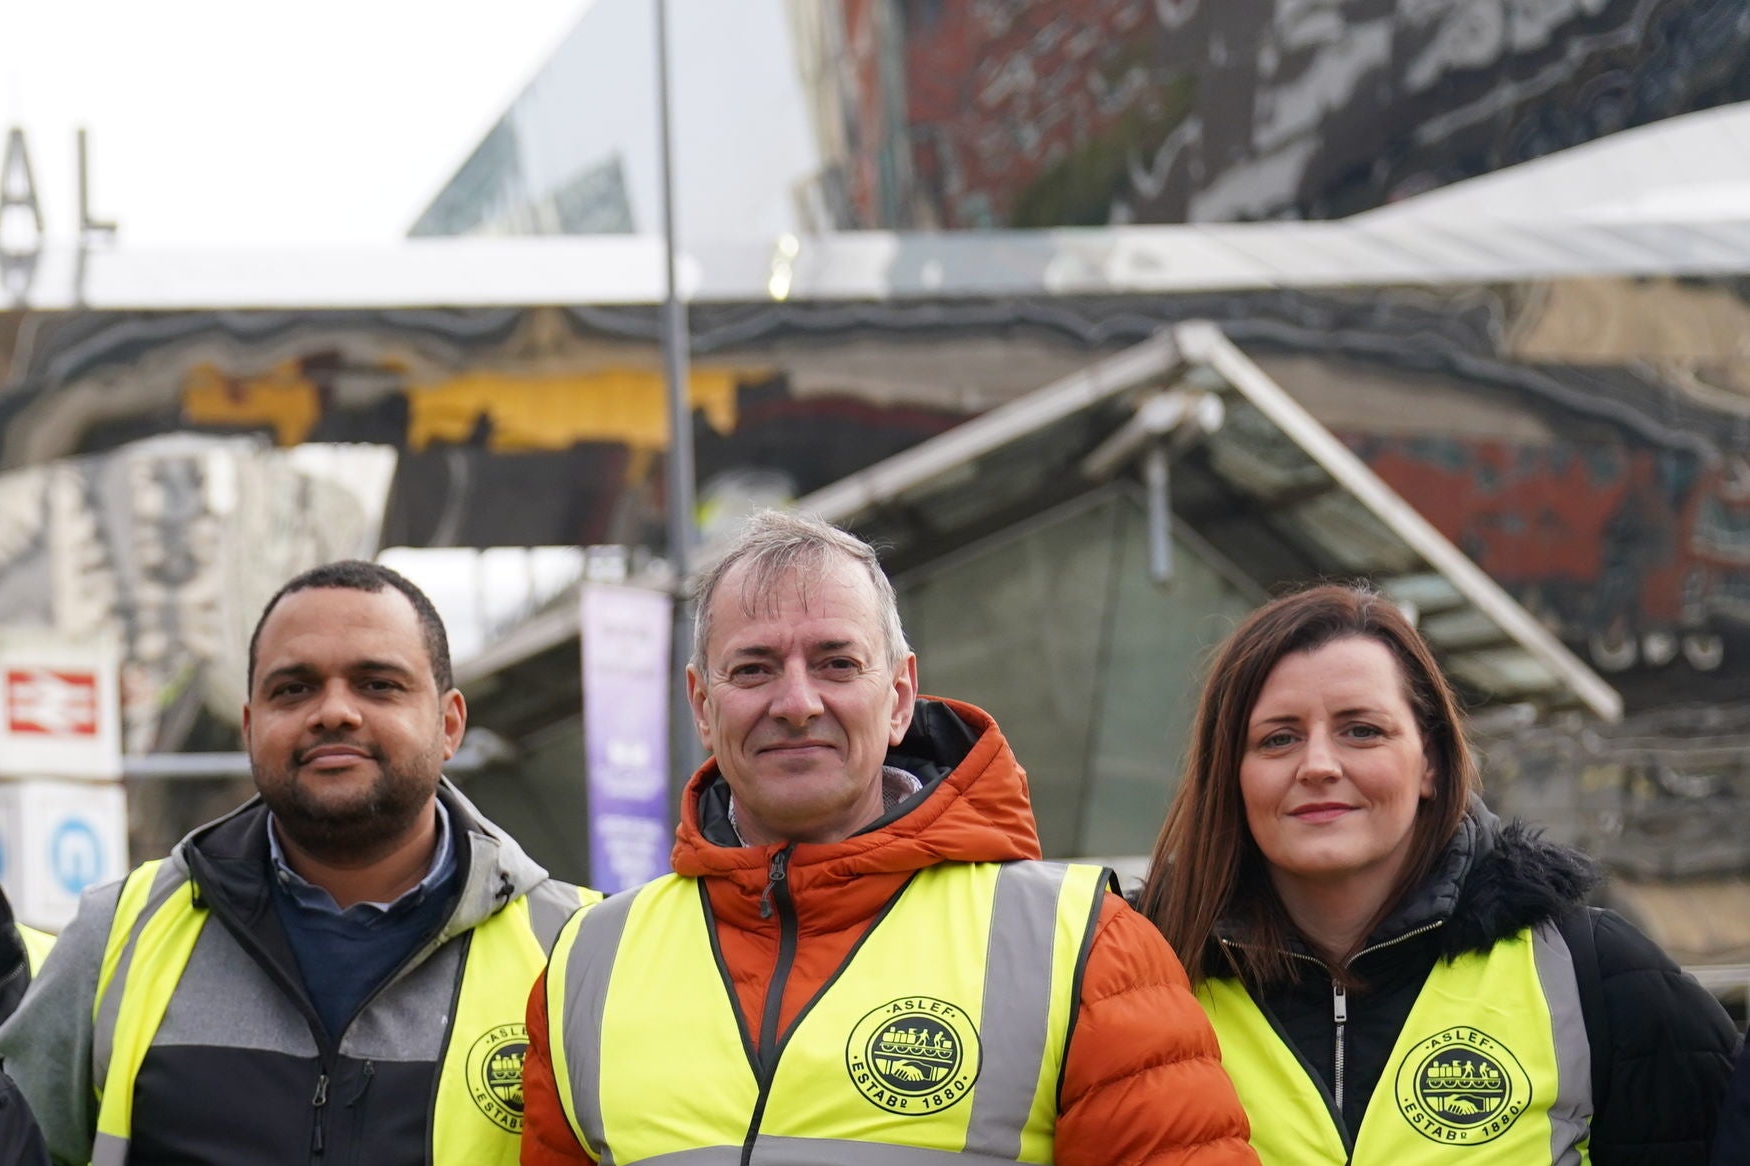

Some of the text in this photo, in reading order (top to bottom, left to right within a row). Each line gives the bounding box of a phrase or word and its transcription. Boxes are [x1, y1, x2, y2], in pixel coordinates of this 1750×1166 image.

[892, 999, 953, 1016] ASLEF
[489, 1027, 528, 1043] ASLE
[1430, 1030, 1491, 1049] ASLEF
[922, 1080, 966, 1109] 1880
[1482, 1104, 1520, 1137] 1880
